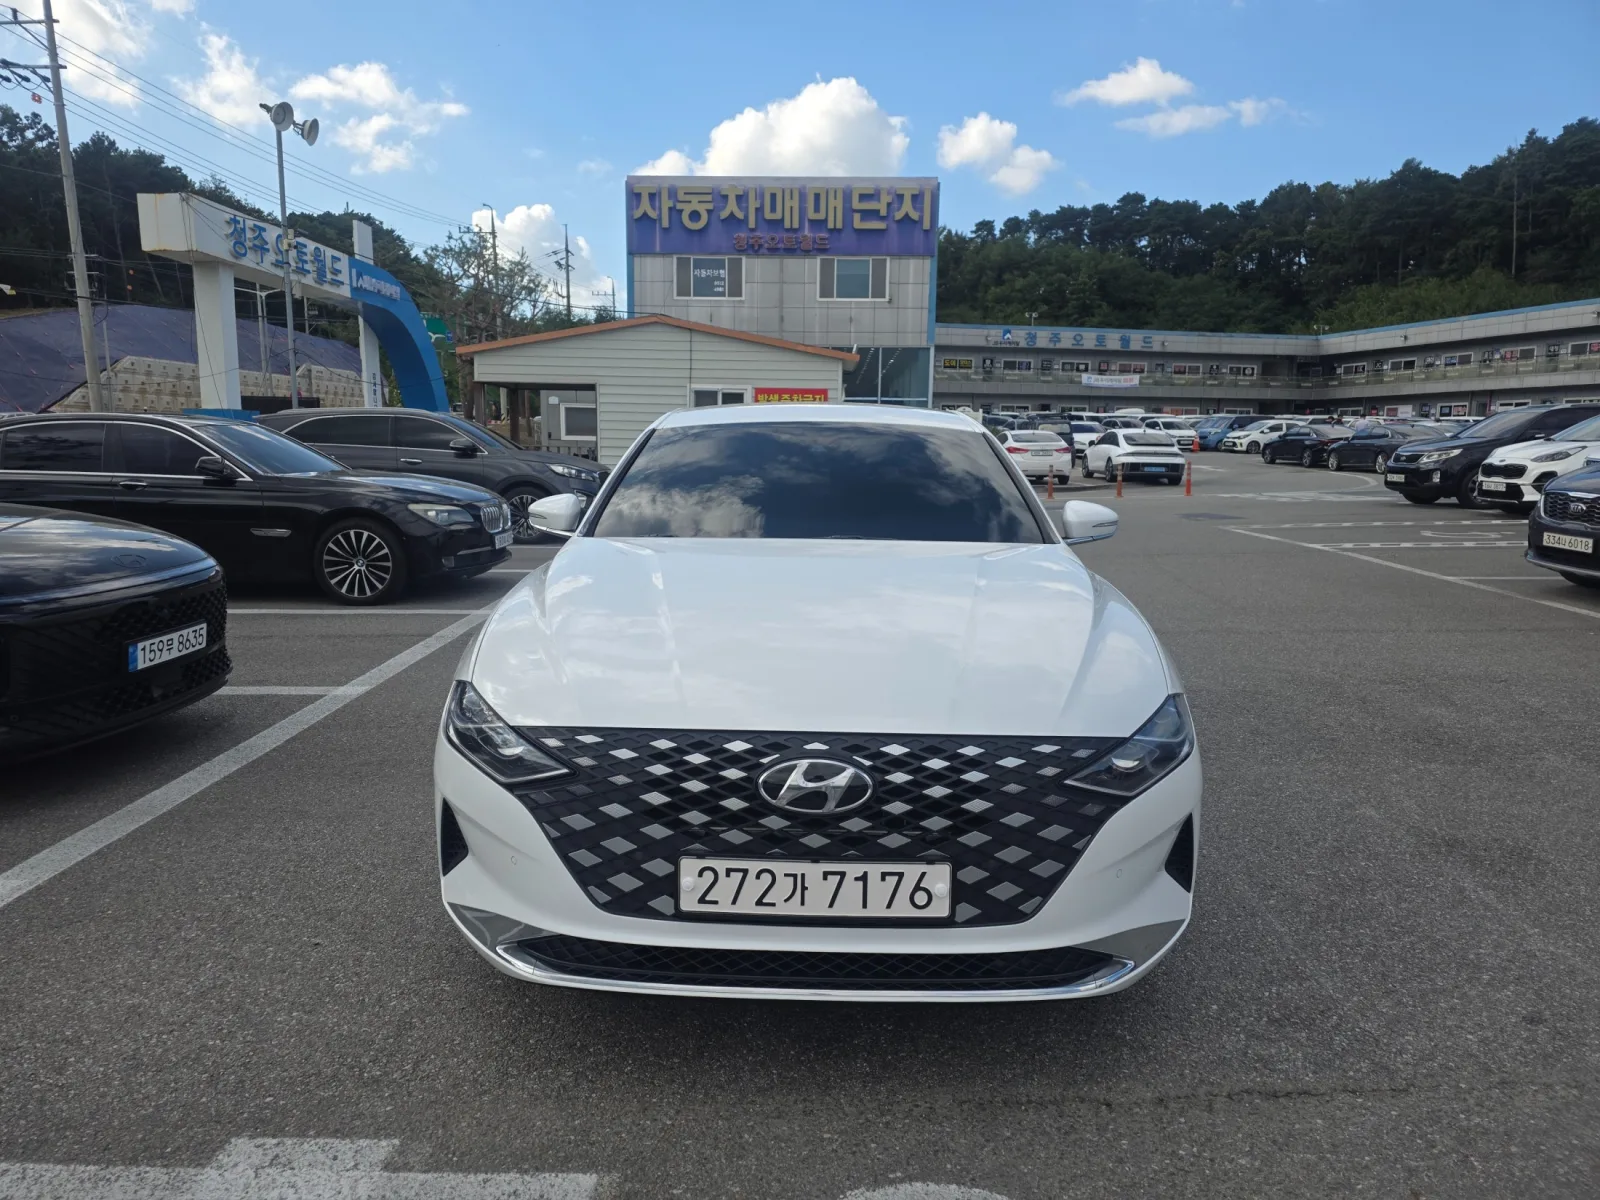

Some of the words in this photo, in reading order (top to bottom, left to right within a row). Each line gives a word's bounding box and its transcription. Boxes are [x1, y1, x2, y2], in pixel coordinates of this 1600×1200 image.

[632, 184, 931, 231] 자동차매매단지
[733, 232, 831, 252] 청주오토월드
[693, 268, 725, 278] 자동차보험
[1024, 330, 1155, 350] 청주오토월드
[1568, 537, 1590, 551] 6018
[140, 638, 174, 665] 159무
[177, 627, 205, 653] 8635
[696, 865, 809, 908] 272가
[821, 870, 934, 910] 7176
